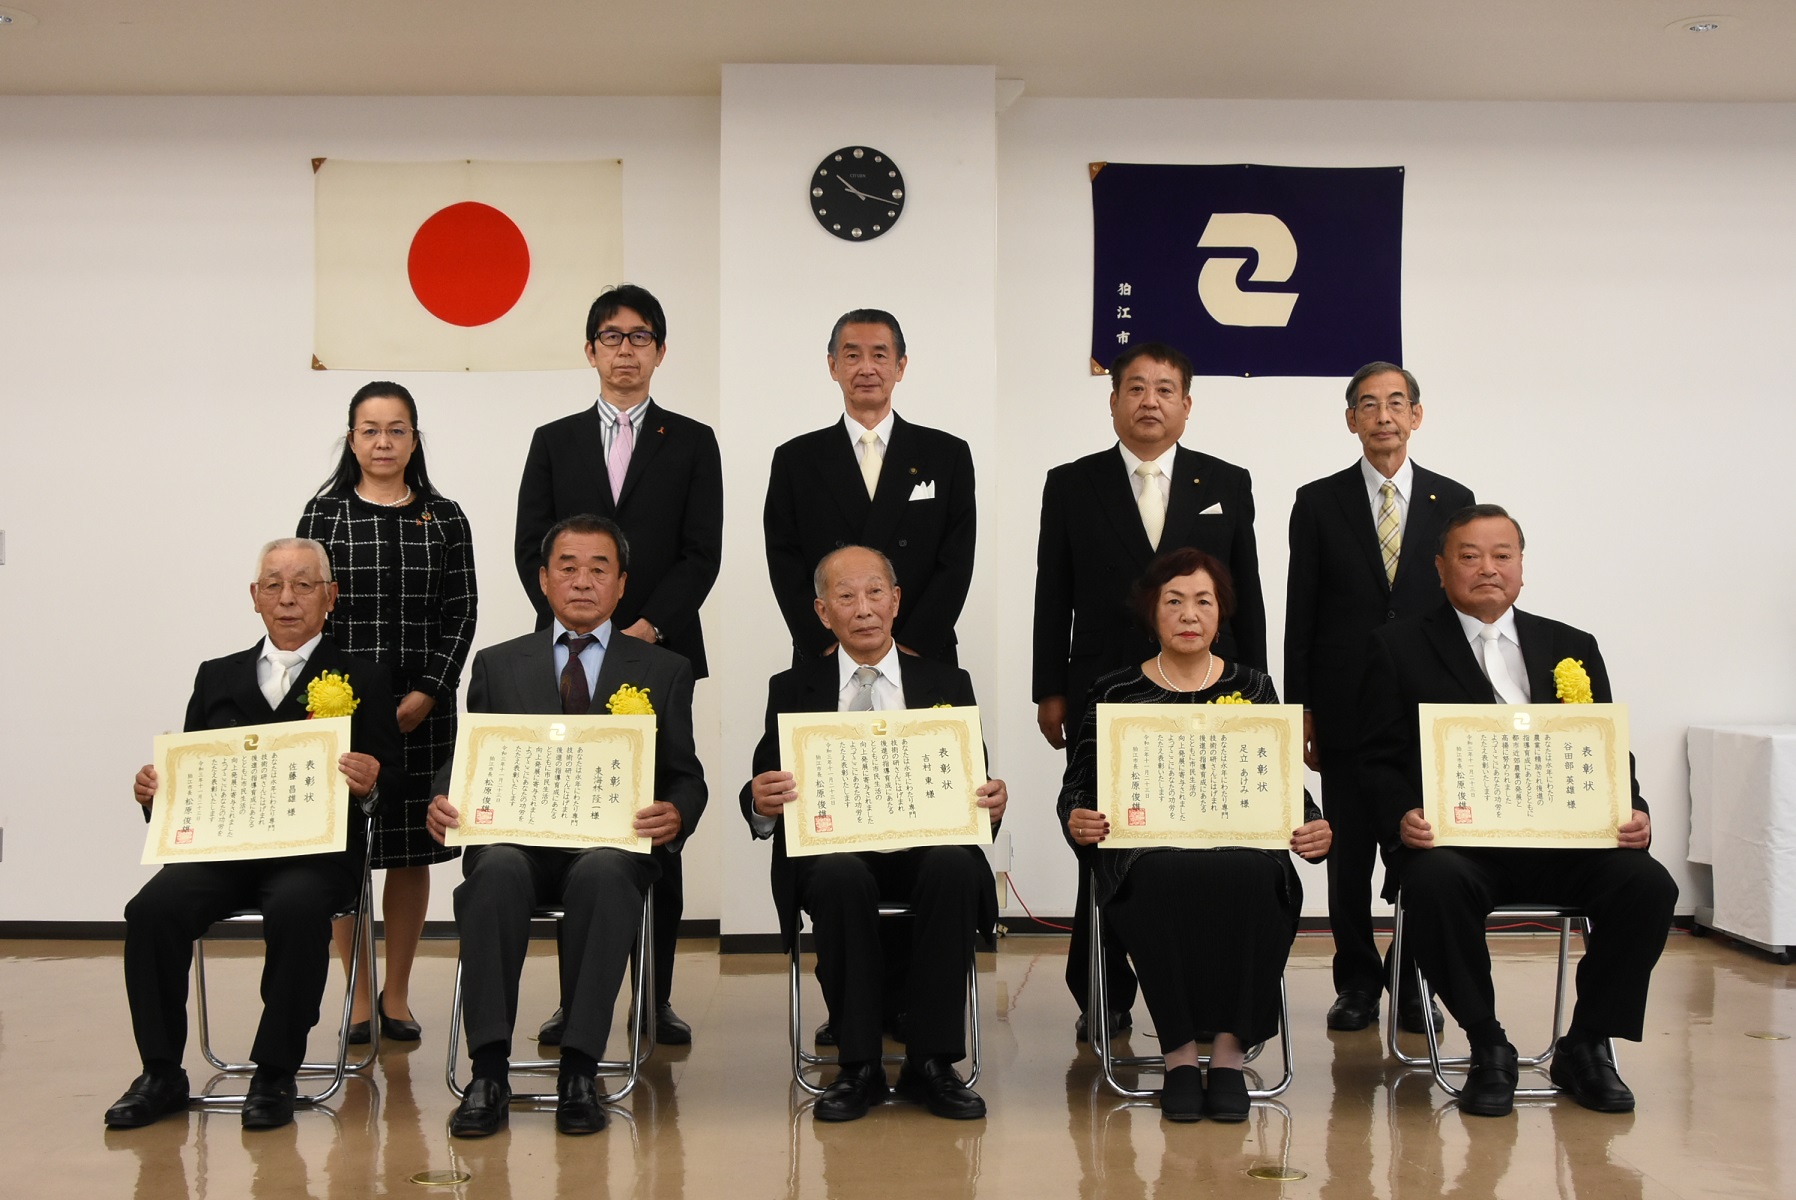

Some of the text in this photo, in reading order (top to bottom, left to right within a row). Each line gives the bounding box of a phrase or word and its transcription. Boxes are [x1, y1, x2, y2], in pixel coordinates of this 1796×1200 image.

[1116, 282, 1132, 345] 狛江市
[304, 760, 315, 802] 表彰状
[609, 759, 621, 804] 表彰状
[938, 748, 953, 790] 表彰状
[1257, 747, 1268, 792] 表彰状
[1582, 746, 1594, 791] 表彰状
